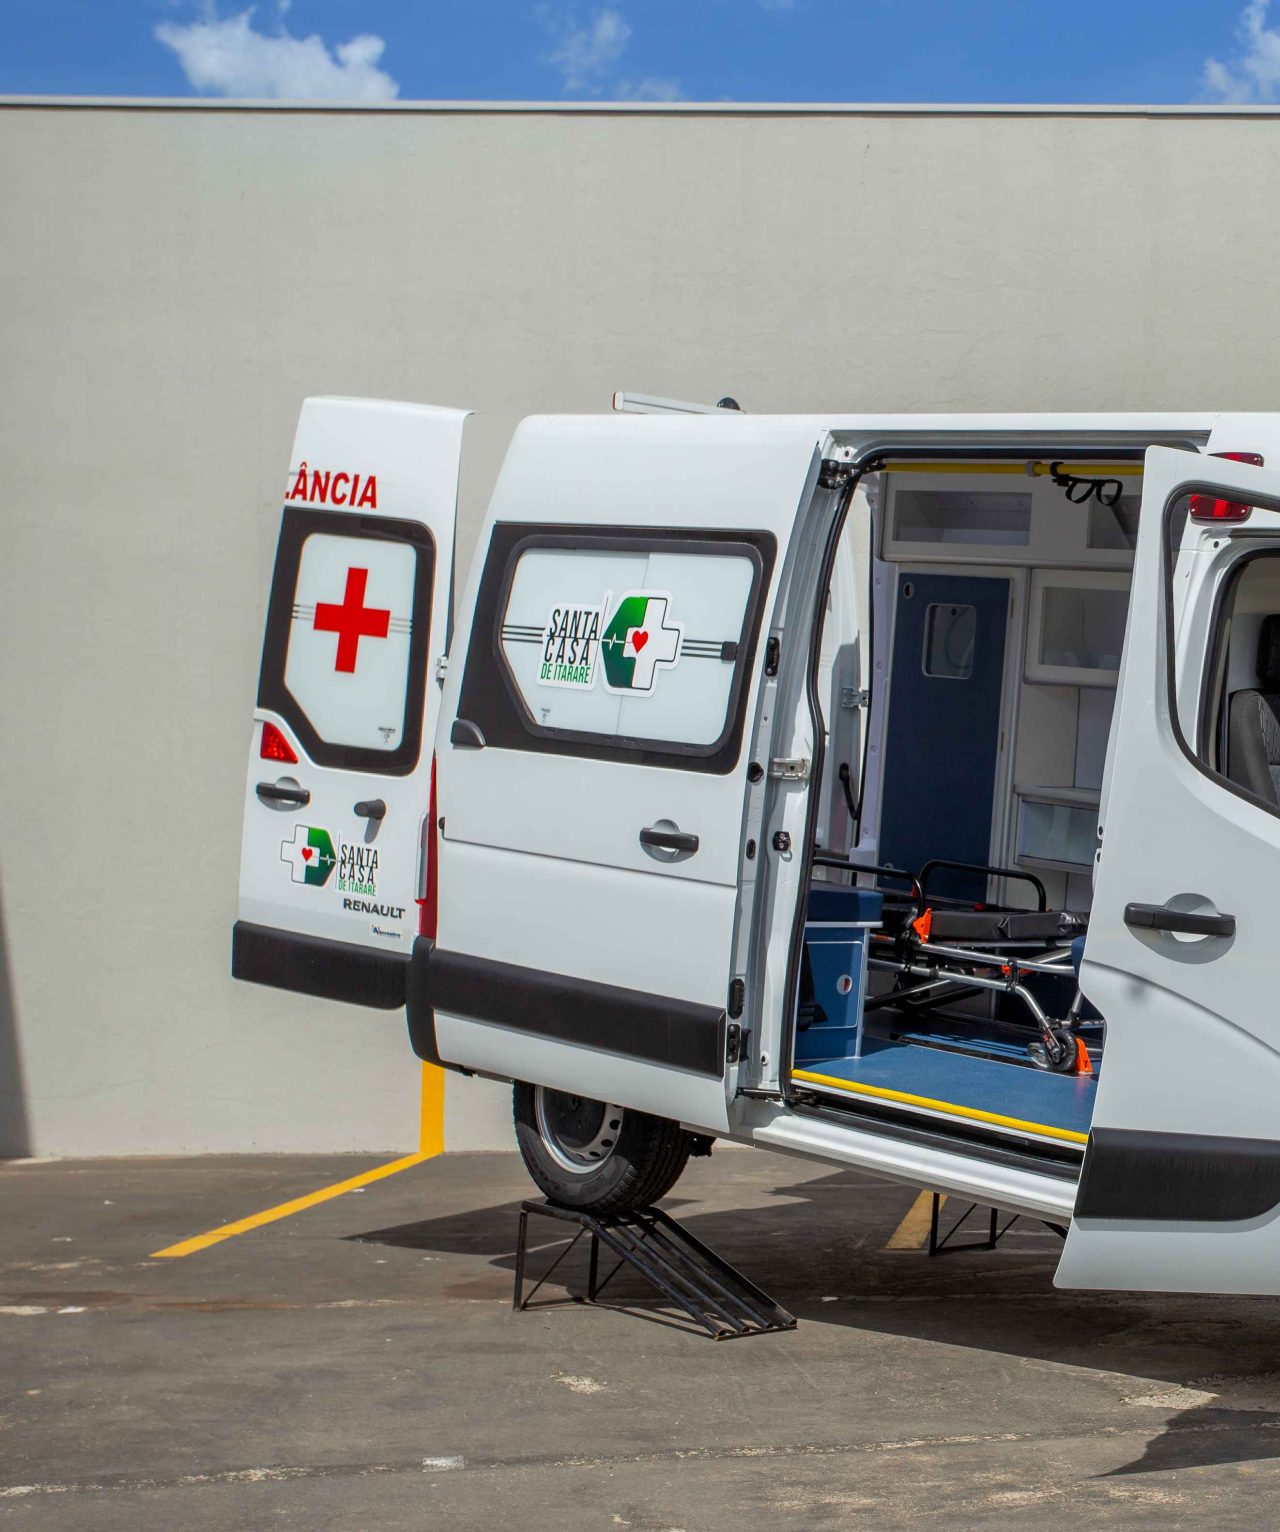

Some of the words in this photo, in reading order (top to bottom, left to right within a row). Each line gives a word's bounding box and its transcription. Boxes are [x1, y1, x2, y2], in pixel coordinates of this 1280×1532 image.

[549, 608, 599, 639] SANTA
[544, 637, 590, 666] CASA
[541, 663, 553, 679] DE
[554, 663, 591, 683] ITARARÉ
[340, 844, 378, 869] SANTA
[339, 862, 374, 884] CASA
[338, 880, 346, 891] DE
[343, 898, 406, 919] RENAULT
